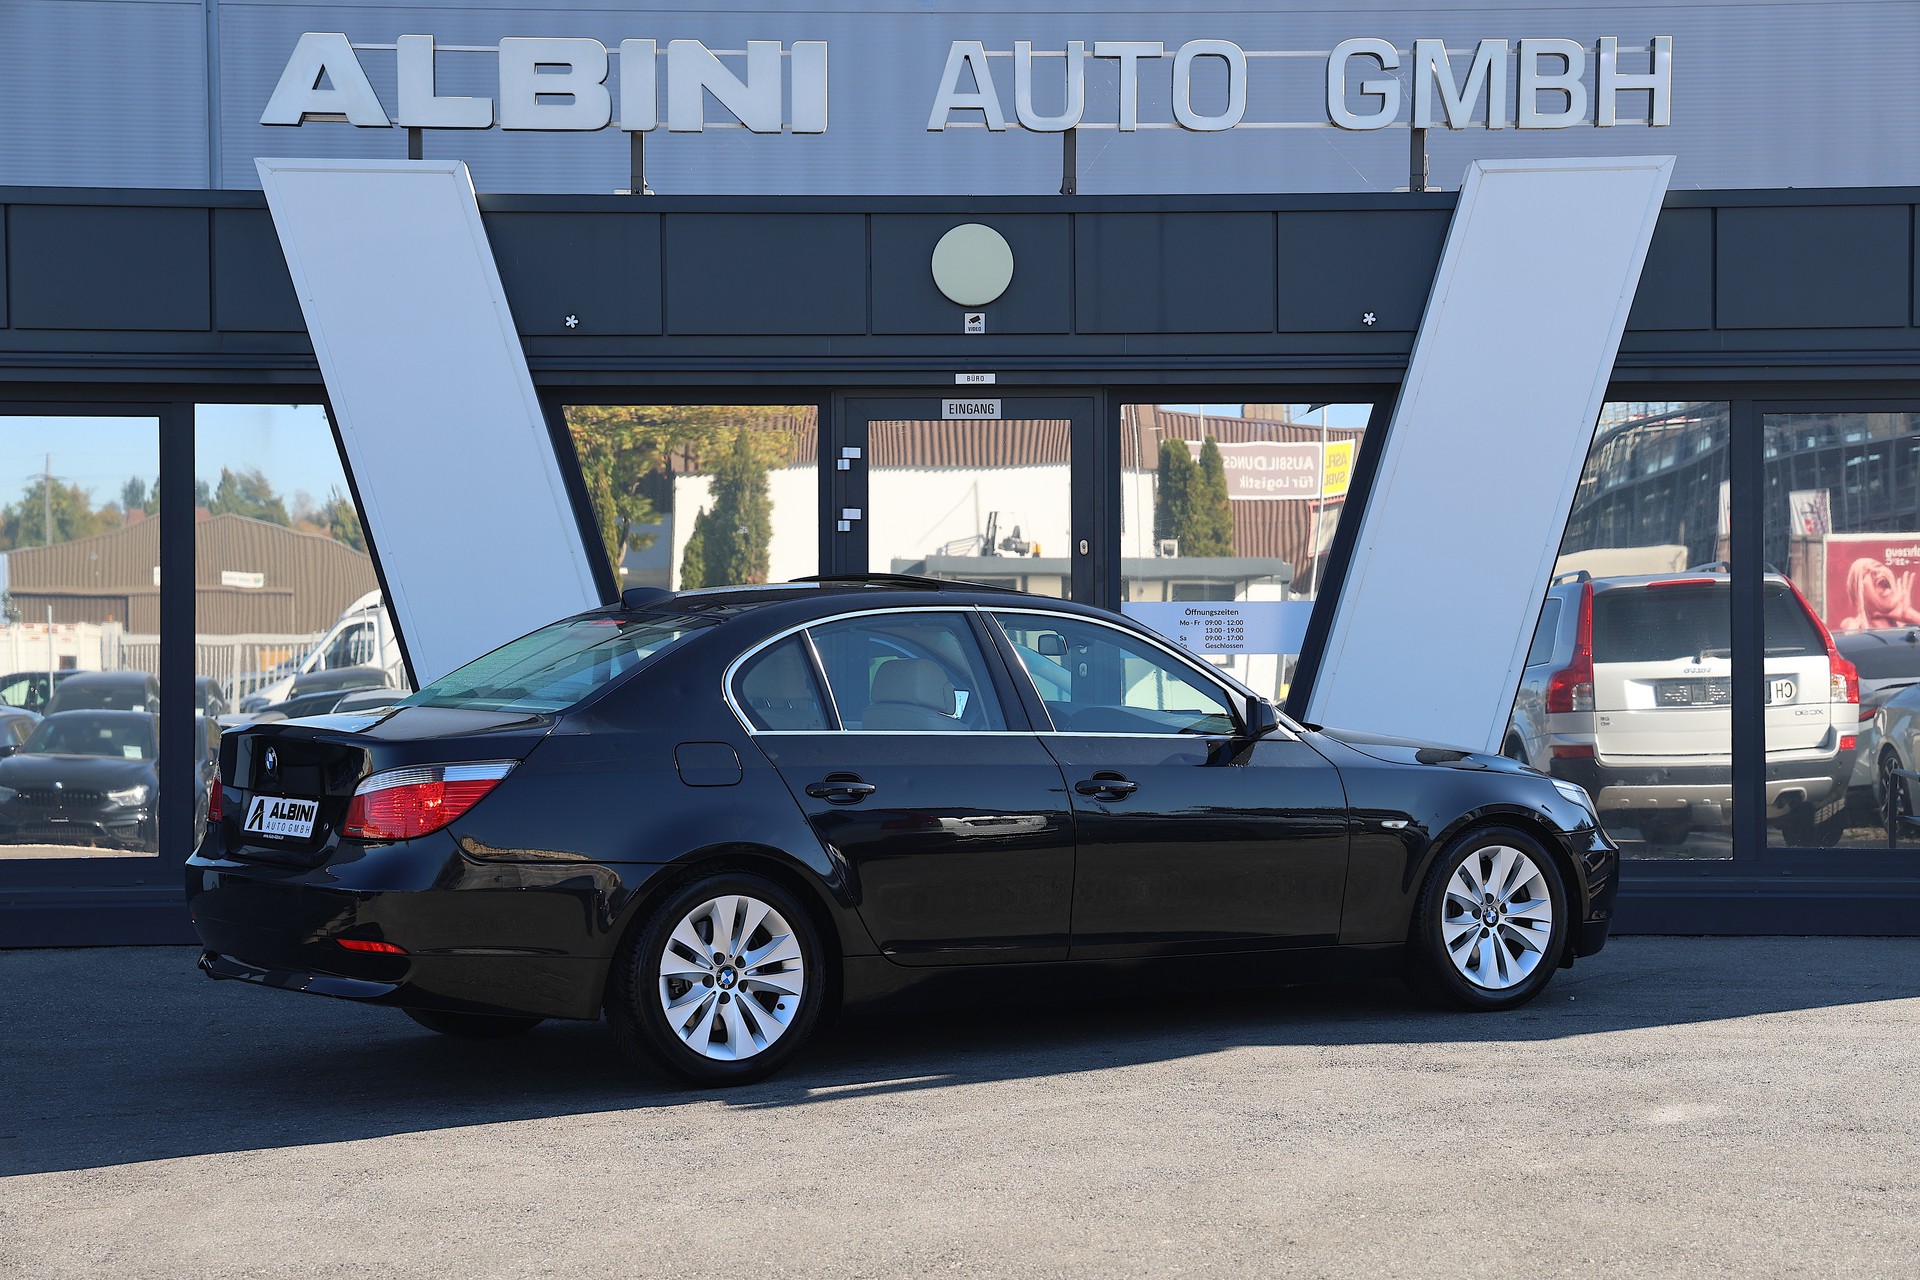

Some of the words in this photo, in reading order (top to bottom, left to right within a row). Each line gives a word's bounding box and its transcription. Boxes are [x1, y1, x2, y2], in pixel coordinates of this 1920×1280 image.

[259, 32, 828, 134] ALBINI
[927, 38, 1247, 132] AUTO
[1325, 35, 1673, 130] GMBH
[966, 374, 985, 382] BÜRO
[949, 403, 995, 414] EINGANG
[1184, 608, 1239, 617] Öffnungszeiten
[269, 802, 315, 823] ALBINI
[265, 821, 286, 832] AUTO
[288, 823, 311, 834] GMBH
